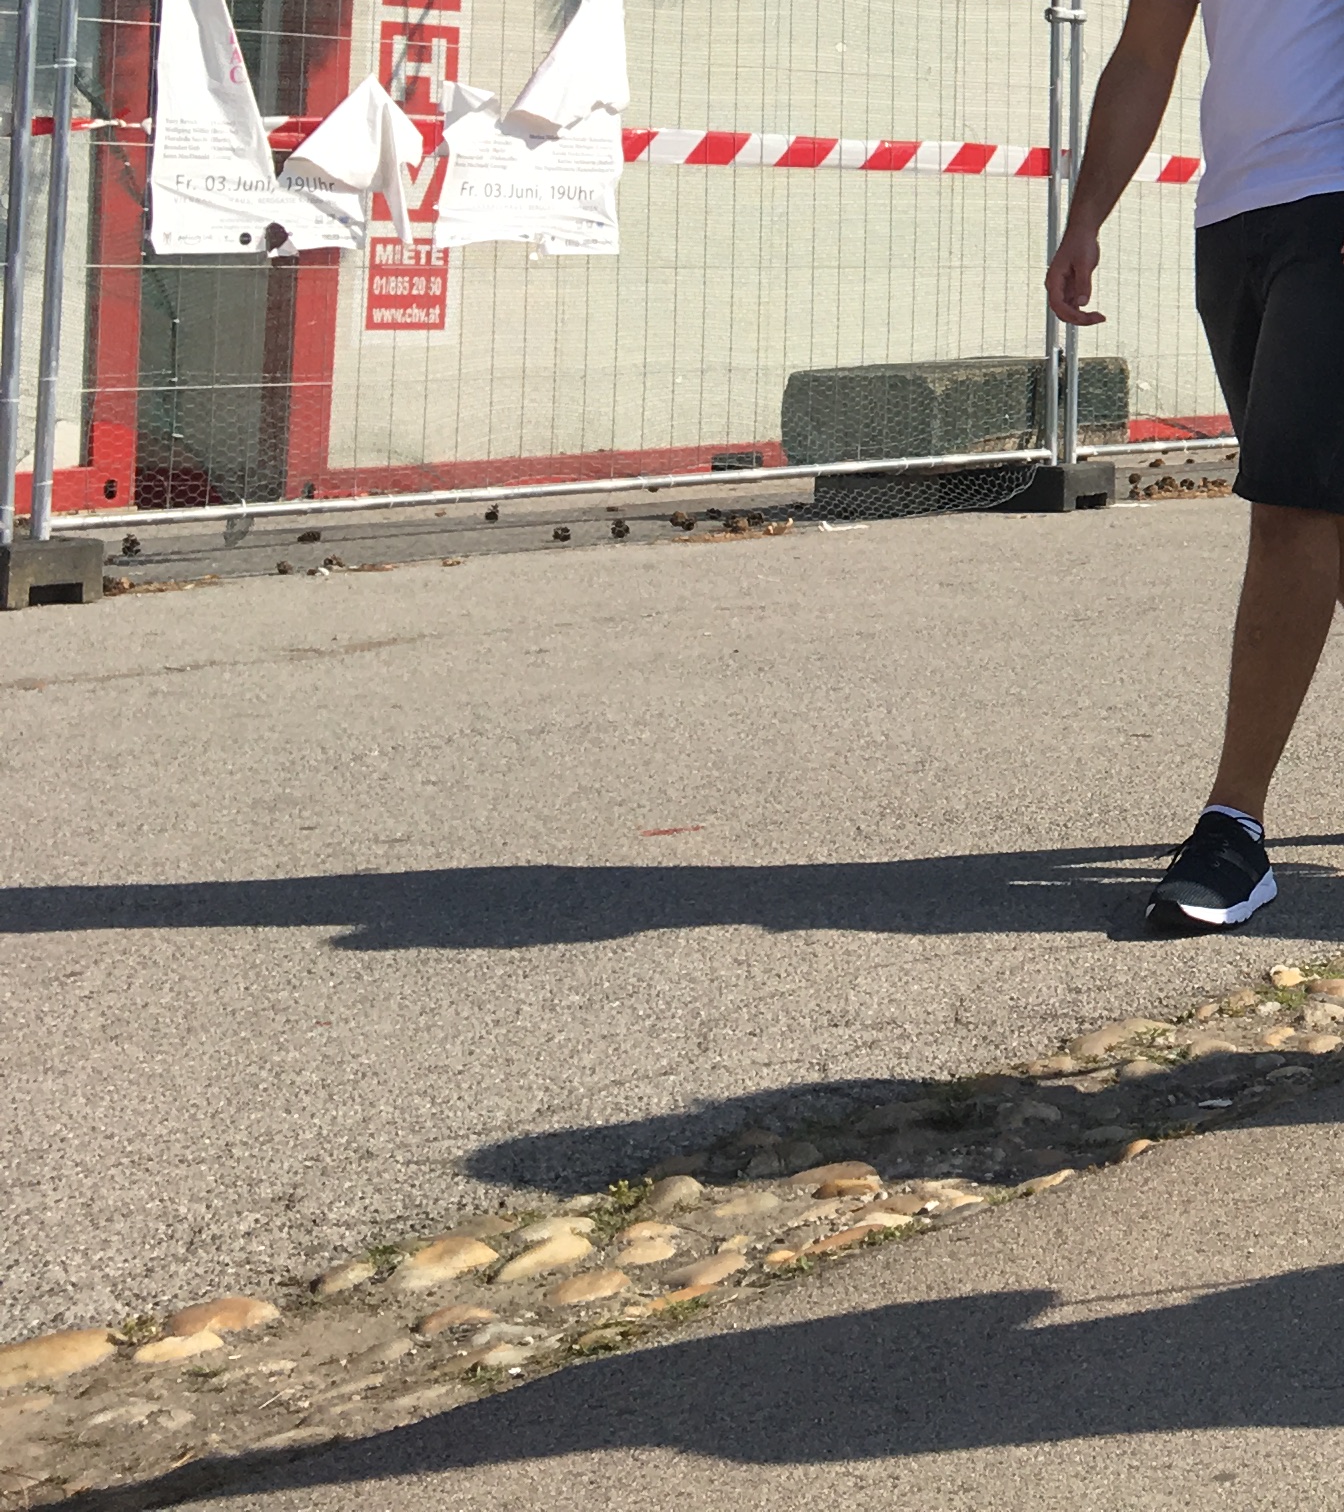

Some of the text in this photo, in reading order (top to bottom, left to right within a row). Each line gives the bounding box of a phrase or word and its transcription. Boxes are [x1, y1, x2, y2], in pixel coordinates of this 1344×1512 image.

[176, 174, 336, 194] Fr. 03.Juni, 19Uhr
[460, 181, 595, 201] Fr. 03.Juni, 19Uhr
[374, 243, 445, 266] MIETE
[411, 276, 426, 296] 20
[372, 303, 441, 324] www.chv.at
